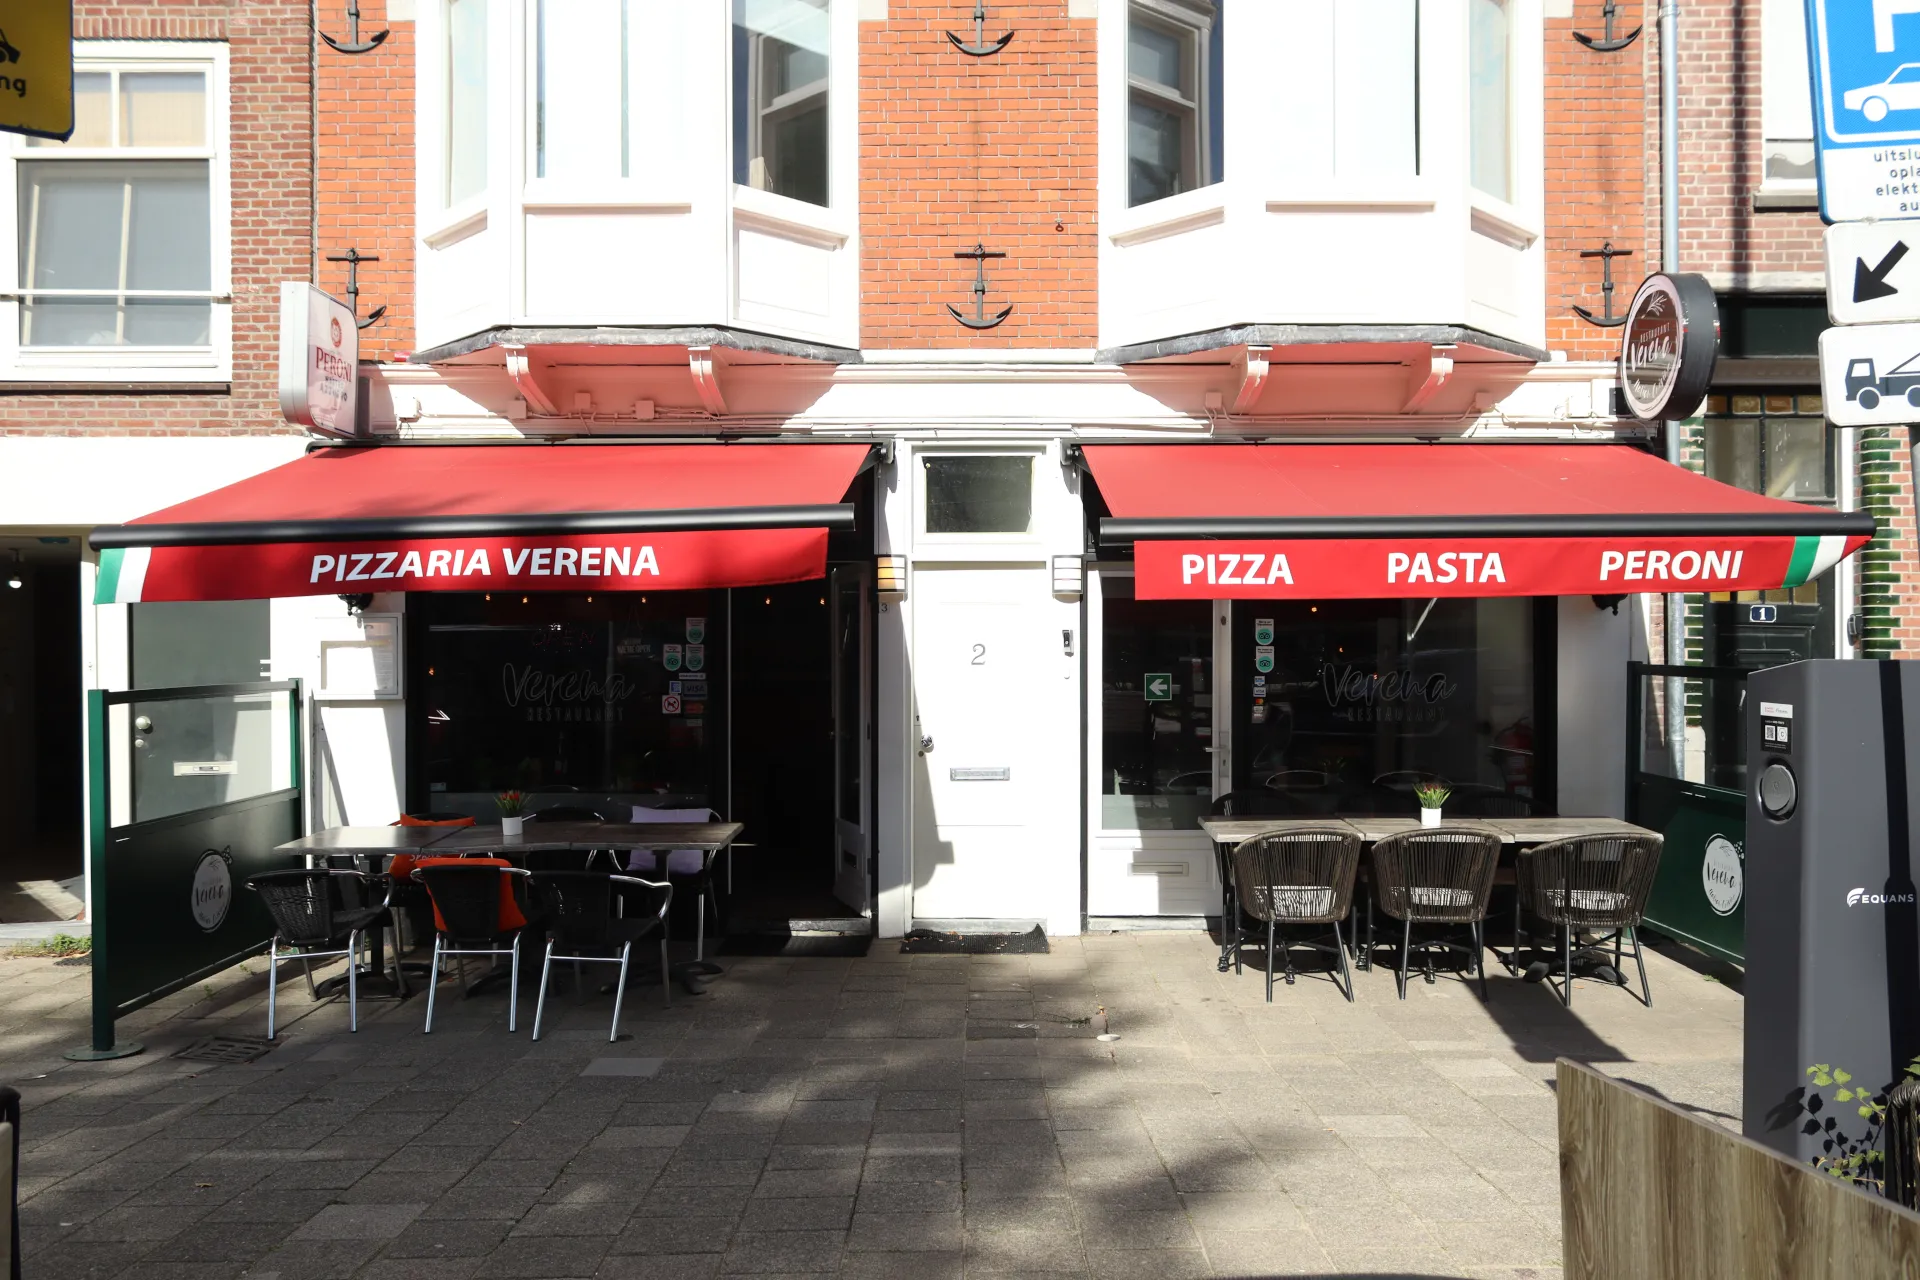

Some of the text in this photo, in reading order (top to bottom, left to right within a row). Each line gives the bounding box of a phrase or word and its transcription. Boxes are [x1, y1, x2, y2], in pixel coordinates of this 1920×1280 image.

[1640, 322, 1670, 344] RESTAURANT
[316, 346, 352, 383] PERONI
[309, 546, 660, 583] PIZZARIA VERENA
[1182, 549, 1744, 585] PIZZA PASTA PERONI
[1759, 607, 1767, 621] 1
[970, 643, 986, 666] 2
[502, 662, 636, 708] Verena
[1323, 662, 1458, 707] Verena
[525, 706, 624, 722] RESTAURANT
[1347, 706, 1446, 722] RESTAURANT
[1861, 893, 1915, 904] EQUANS
